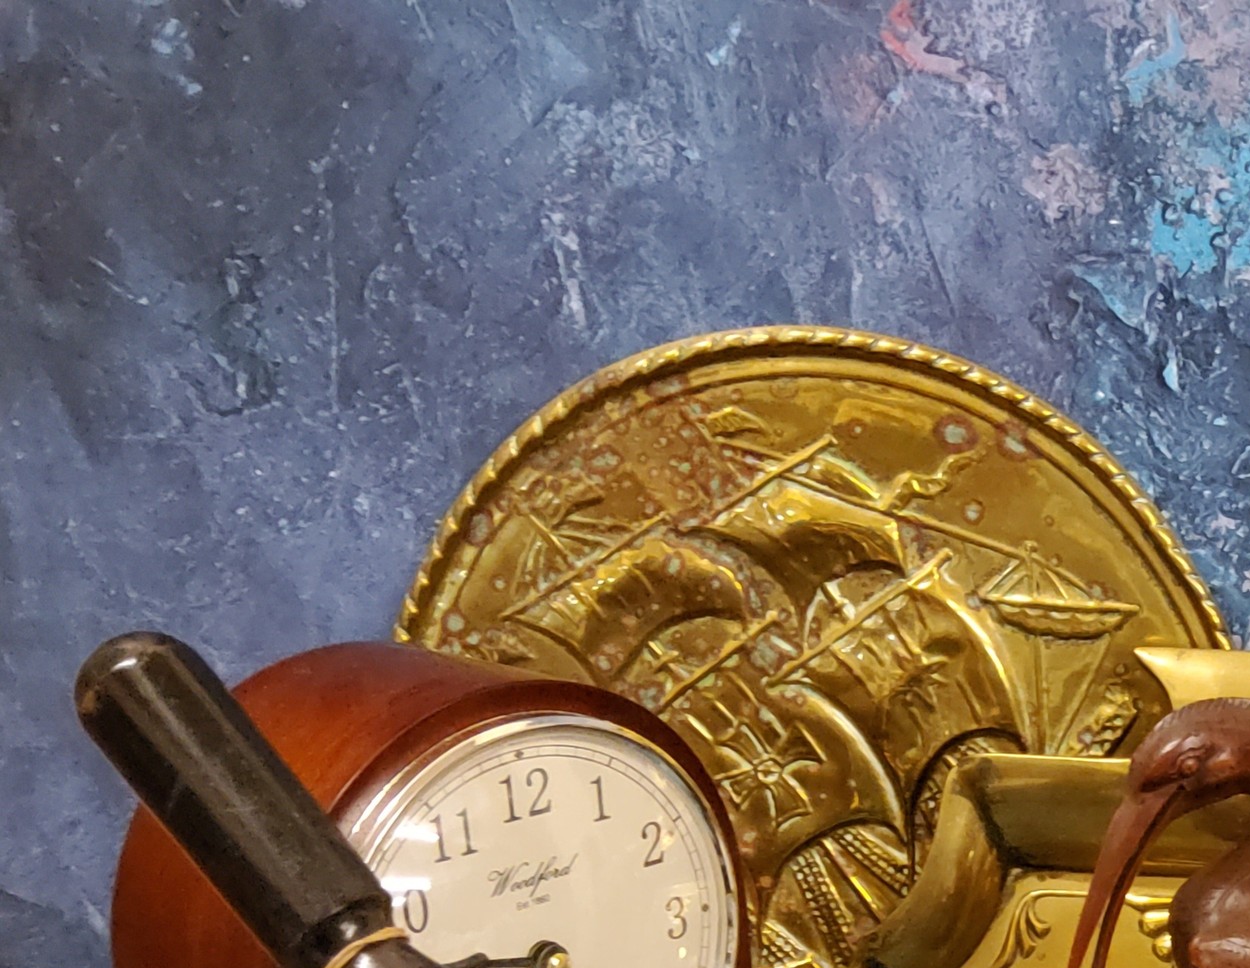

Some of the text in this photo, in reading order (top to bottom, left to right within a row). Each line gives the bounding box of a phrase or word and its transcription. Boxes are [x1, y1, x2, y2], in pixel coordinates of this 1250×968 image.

[499, 768, 551, 823] 12
[591, 775, 611, 822] 1
[429, 808, 478, 863] 11
[641, 821, 663, 867] 2
[487, 852, 579, 898] Woodford
[403, 889, 428, 933] 0
[665, 896, 688, 939] 3
